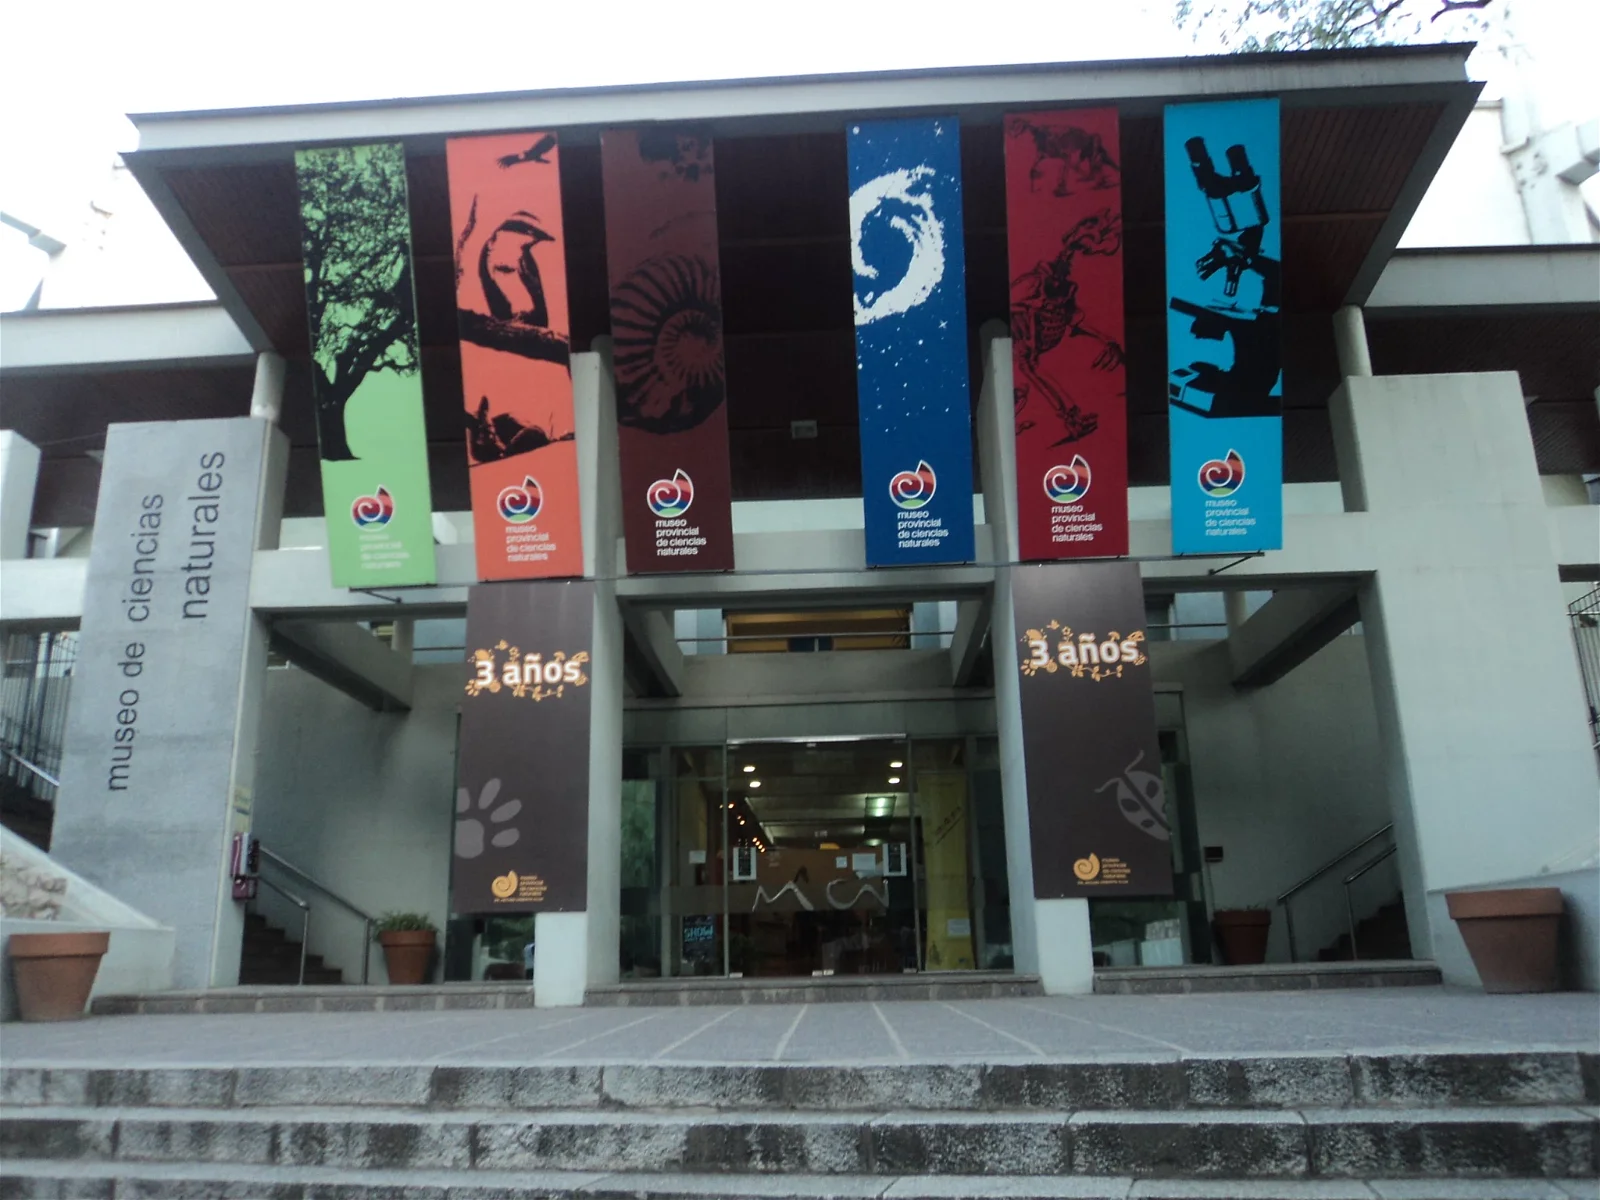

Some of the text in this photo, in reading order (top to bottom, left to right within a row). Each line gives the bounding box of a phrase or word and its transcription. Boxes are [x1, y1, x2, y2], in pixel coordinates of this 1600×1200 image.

[1205, 499, 1237, 507] museo
[1051, 504, 1083, 513] museo
[1205, 507, 1249, 517] provincial
[897, 510, 929, 519] museo
[1052, 512, 1096, 523] provincial
[655, 518, 687, 527] museo
[898, 518, 941, 530] provincial
[1205, 517, 1256, 527] de ciencias
[506, 525, 536, 533] museo
[656, 527, 699, 538] provincial
[898, 528, 949, 538] de ciencias
[1051, 523, 1103, 533] de ciencias
[1206, 527, 1247, 536] naturales
[182, 451, 225, 619] naturales
[506, 533, 549, 543] provincial
[1052, 533, 1094, 542] naturales
[656, 536, 707, 546] de ciencias
[898, 538, 940, 548] naturales
[506, 543, 556, 552] de ciencias
[657, 546, 698, 556] naturales
[507, 553, 548, 562] naturales
[108, 494, 164, 791] museo de ciencias
[1030, 632, 1138, 666] 3 años
[475, 653, 581, 686] 3 años
